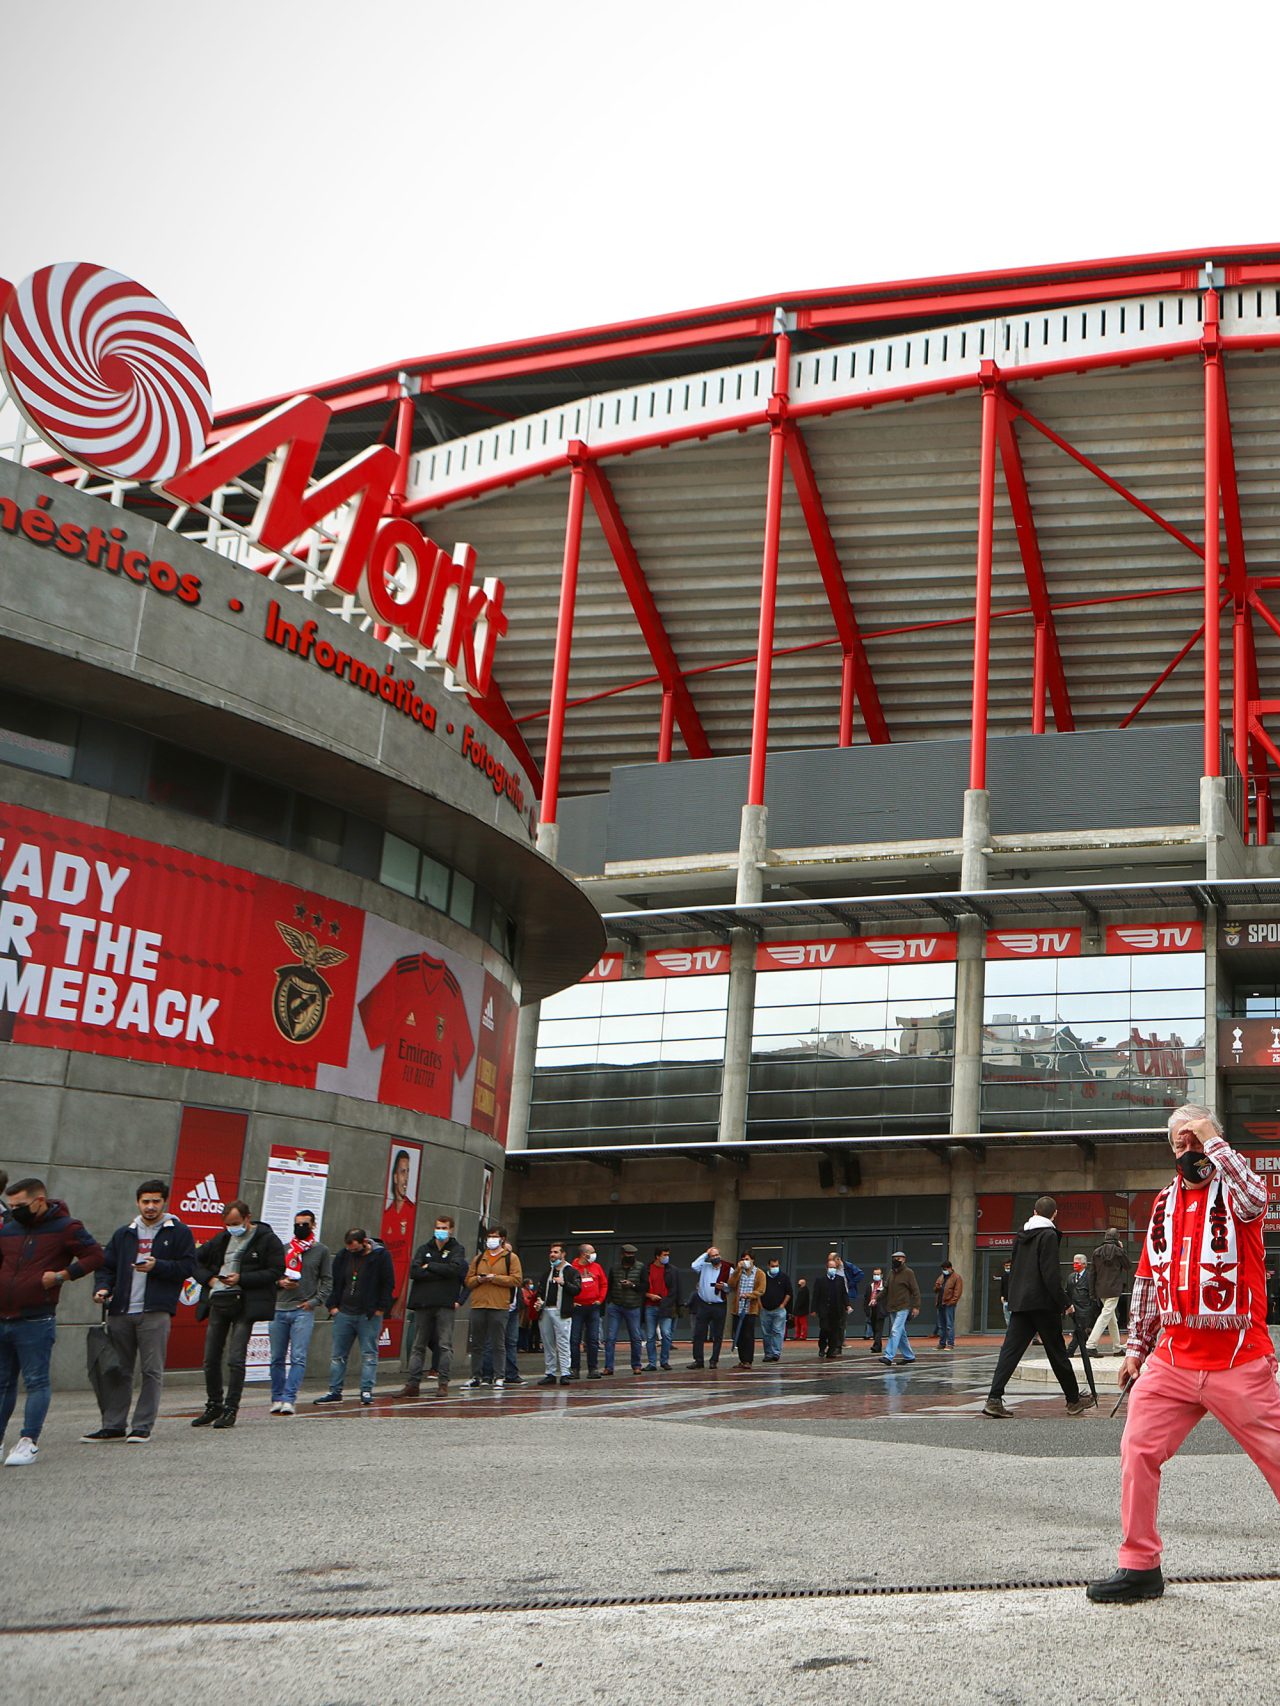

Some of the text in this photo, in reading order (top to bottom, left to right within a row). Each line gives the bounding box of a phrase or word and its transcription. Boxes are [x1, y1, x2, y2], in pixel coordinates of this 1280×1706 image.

[151, 393, 508, 698] Markt
[265, 598, 437, 732] Informática
[59, 912, 162, 981] THE
[997, 933, 1071, 953] BTV
[1116, 928, 1192, 948] BTV
[766, 944, 836, 964] BTV
[865, 939, 937, 959] BTV
[655, 951, 722, 971] BTV
[398, 1038, 442, 1070] Emirates
[1235, 1054, 1239, 1063] 1
[180, 1198, 225, 1214] adidas
